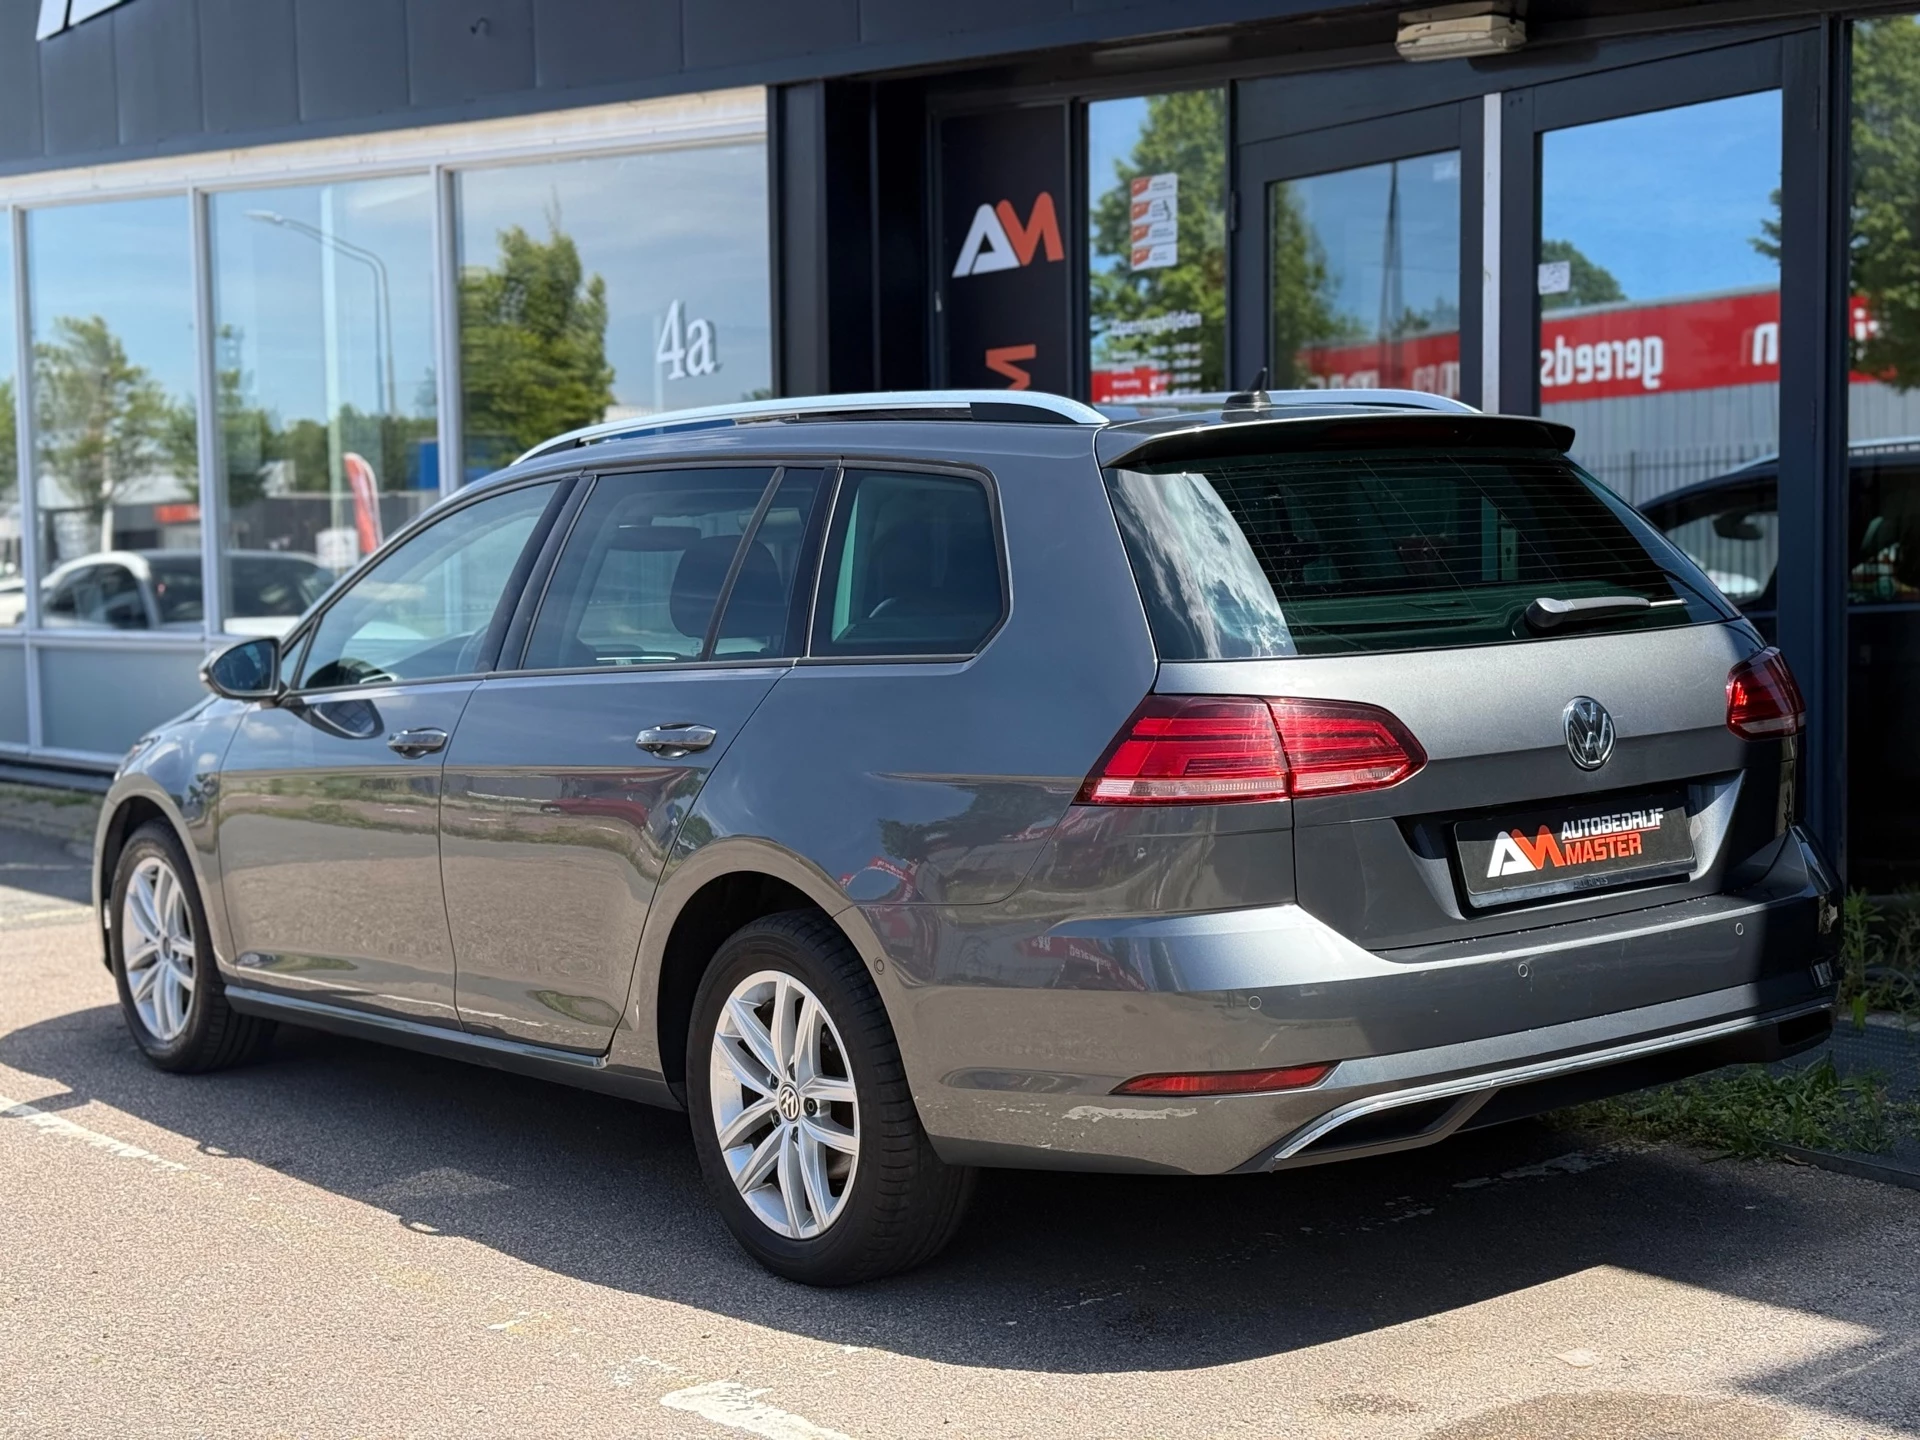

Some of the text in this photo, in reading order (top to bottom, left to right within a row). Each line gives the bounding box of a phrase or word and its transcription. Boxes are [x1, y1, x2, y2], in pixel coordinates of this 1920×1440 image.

[952, 192, 1065, 278] AM
[657, 299, 716, 380] 4a
[1560, 808, 1664, 841] AUTOBEDRIJF
[1565, 832, 1643, 866] MASTER
[1486, 825, 1567, 878] AM
